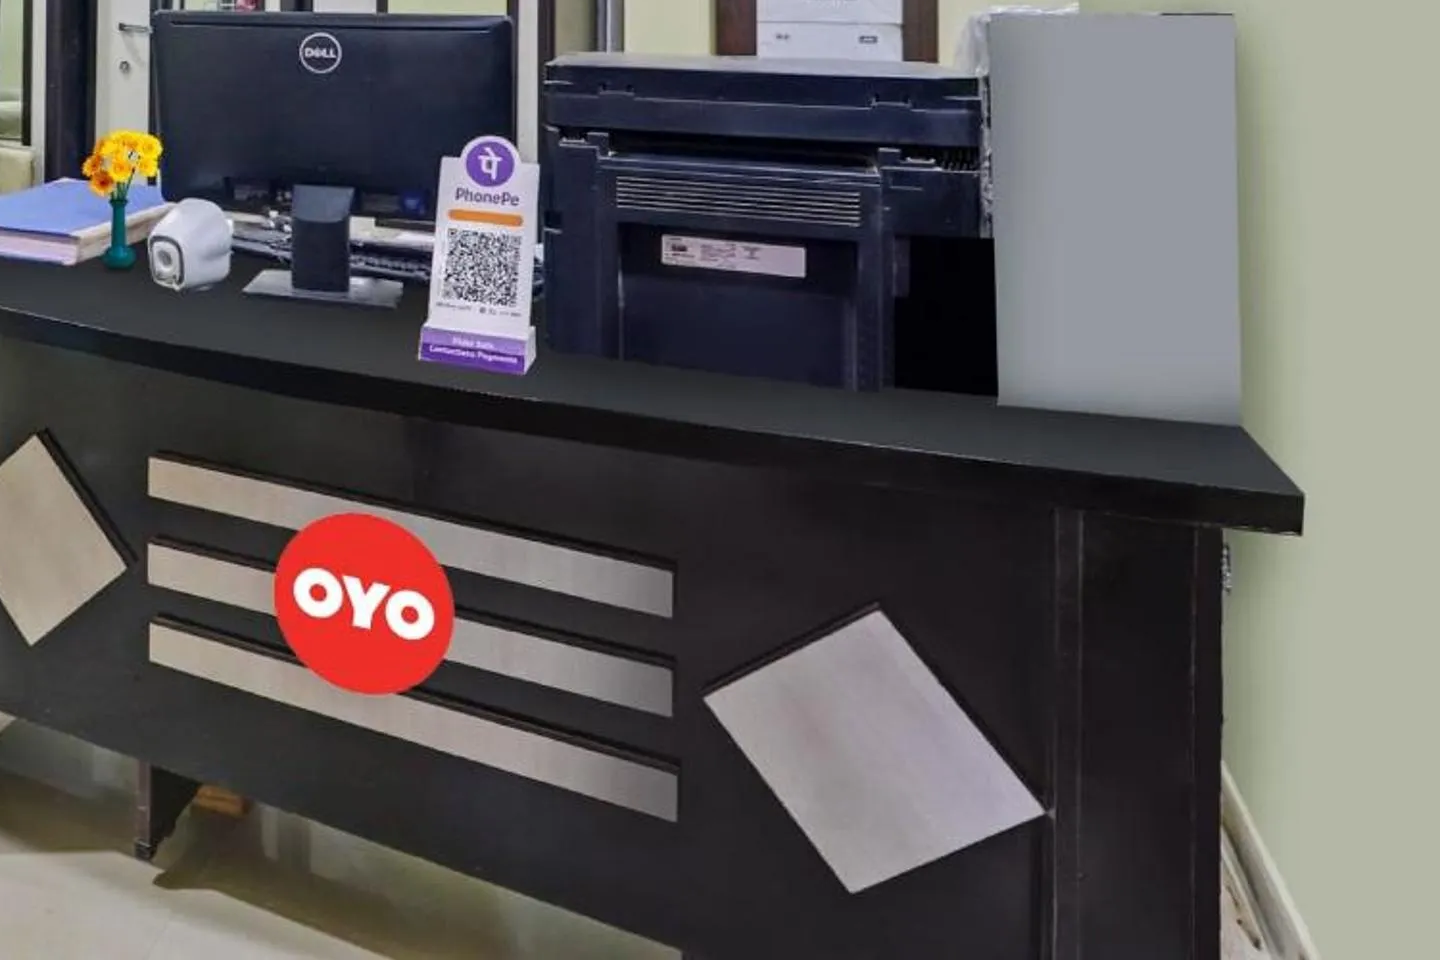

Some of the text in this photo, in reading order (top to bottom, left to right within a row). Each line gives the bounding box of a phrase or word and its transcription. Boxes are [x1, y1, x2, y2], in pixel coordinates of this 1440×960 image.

[304, 47, 337, 59] DELL
[455, 187, 520, 207] PhonePe
[293, 567, 436, 641] OYO
